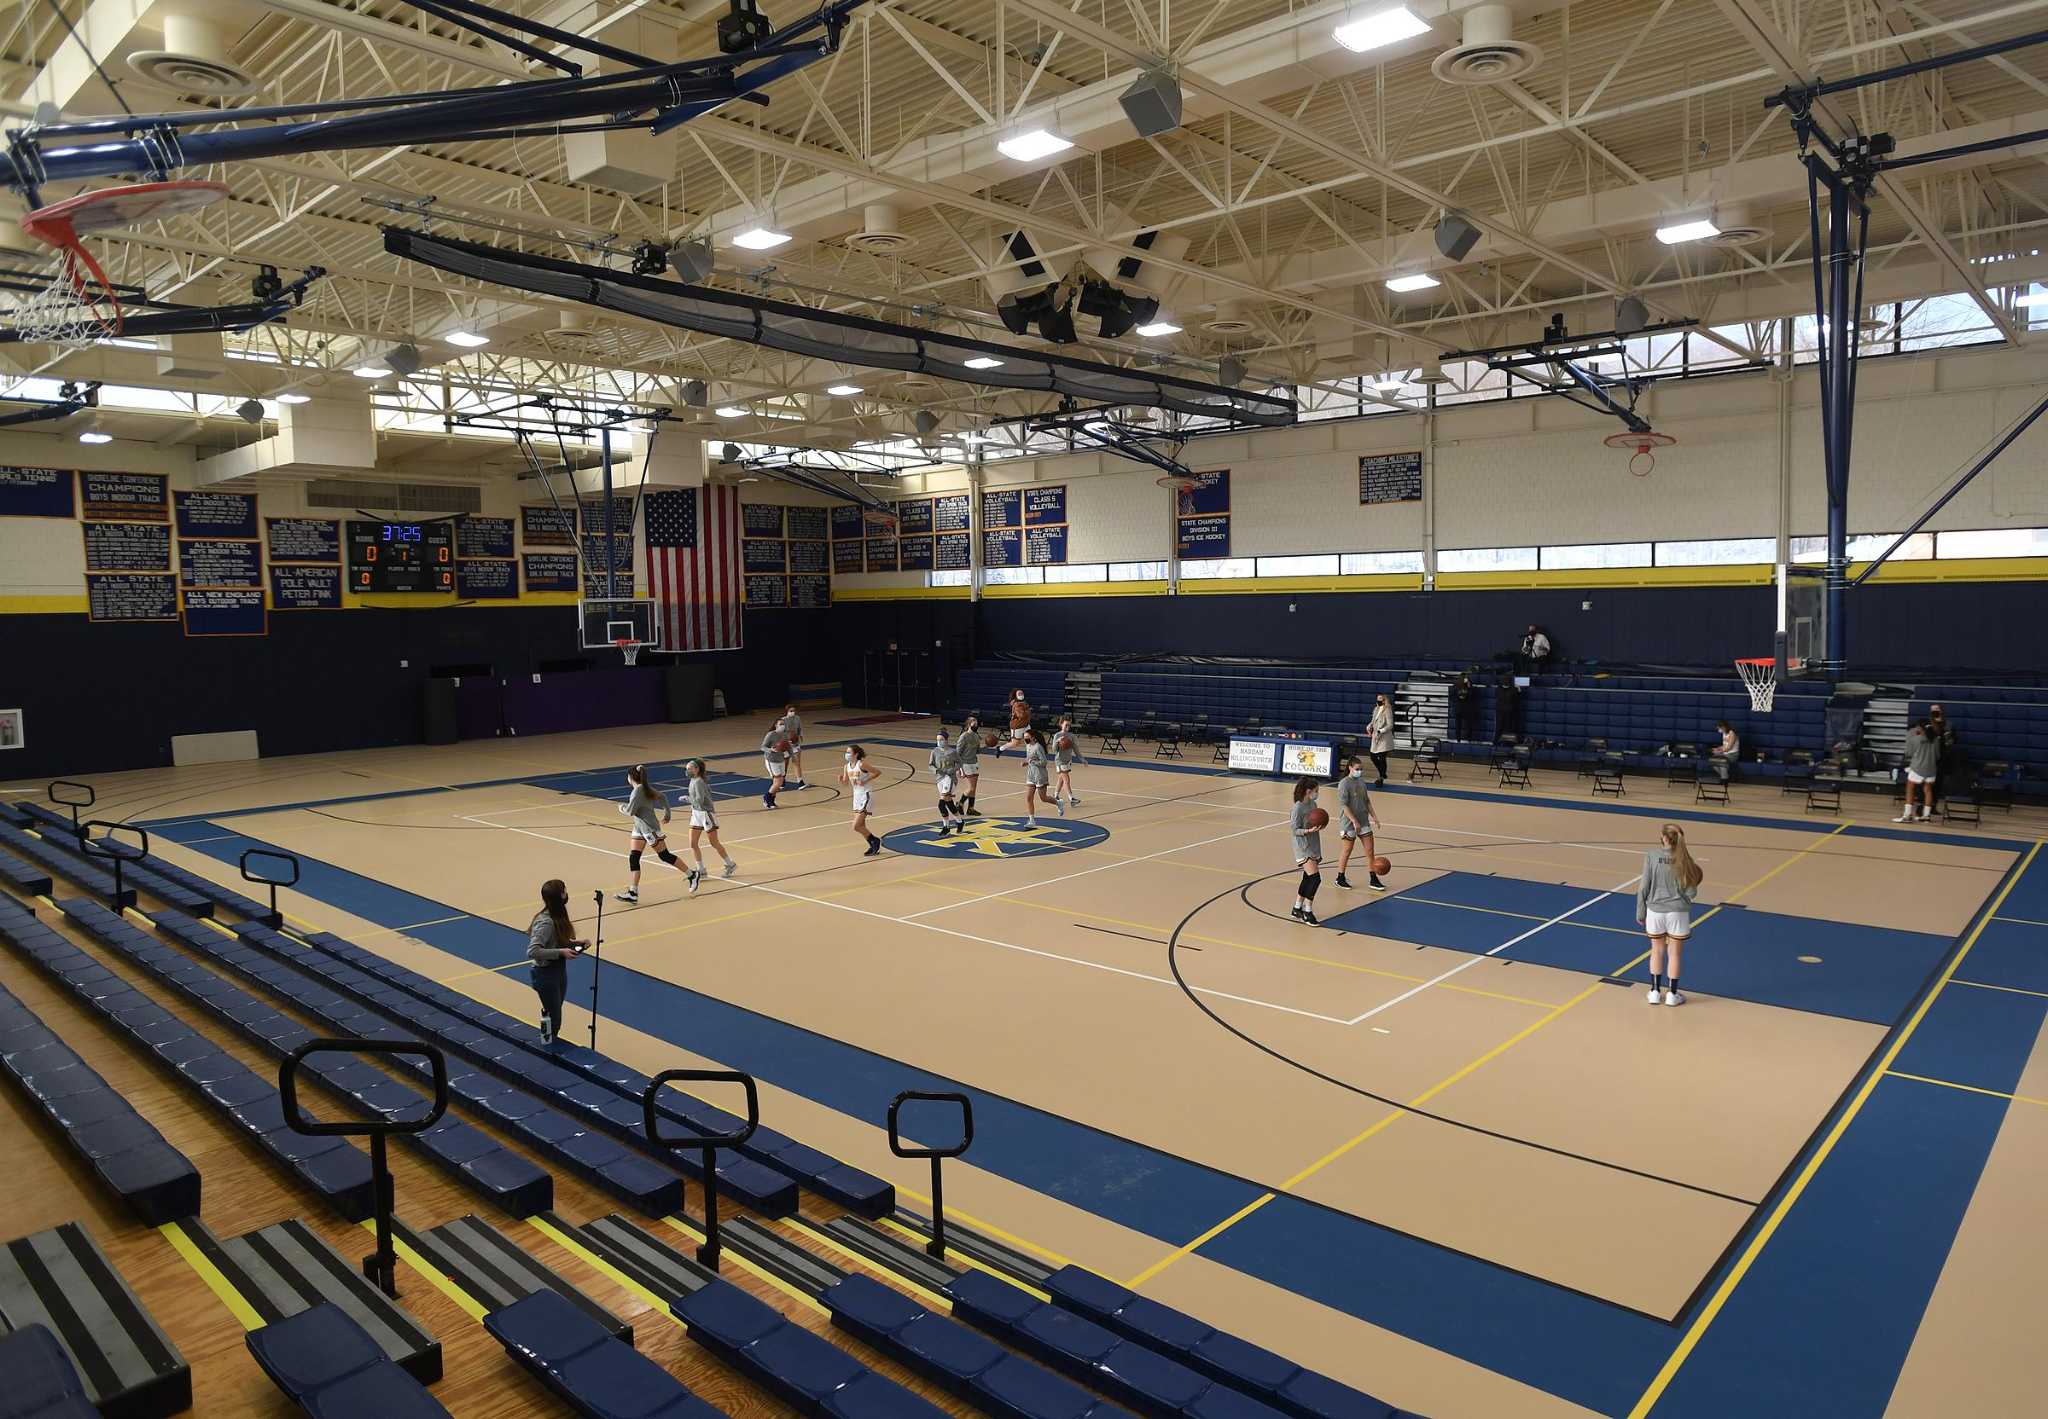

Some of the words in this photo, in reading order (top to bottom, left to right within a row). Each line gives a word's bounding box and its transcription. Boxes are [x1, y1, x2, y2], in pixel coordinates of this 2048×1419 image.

[0, 466, 57, 476] LL-STATE
[88, 484, 160, 494] CHAMPIONS
[987, 491, 1016, 499] ALL-STATE
[1029, 502, 1061, 510] VOLLEYBALL
[194, 542, 247, 550] ALL-STATE
[367, 546, 377, 561] 0
[439, 547, 449, 562] 0
[274, 568, 337, 577] ALL-AMERICAN
[362, 573, 370, 584] 0
[280, 579, 304, 588] POLE
[306, 579, 332, 588] VAULT
[282, 590, 310, 599] PETER
[1284, 761, 1329, 774] COUGARS
